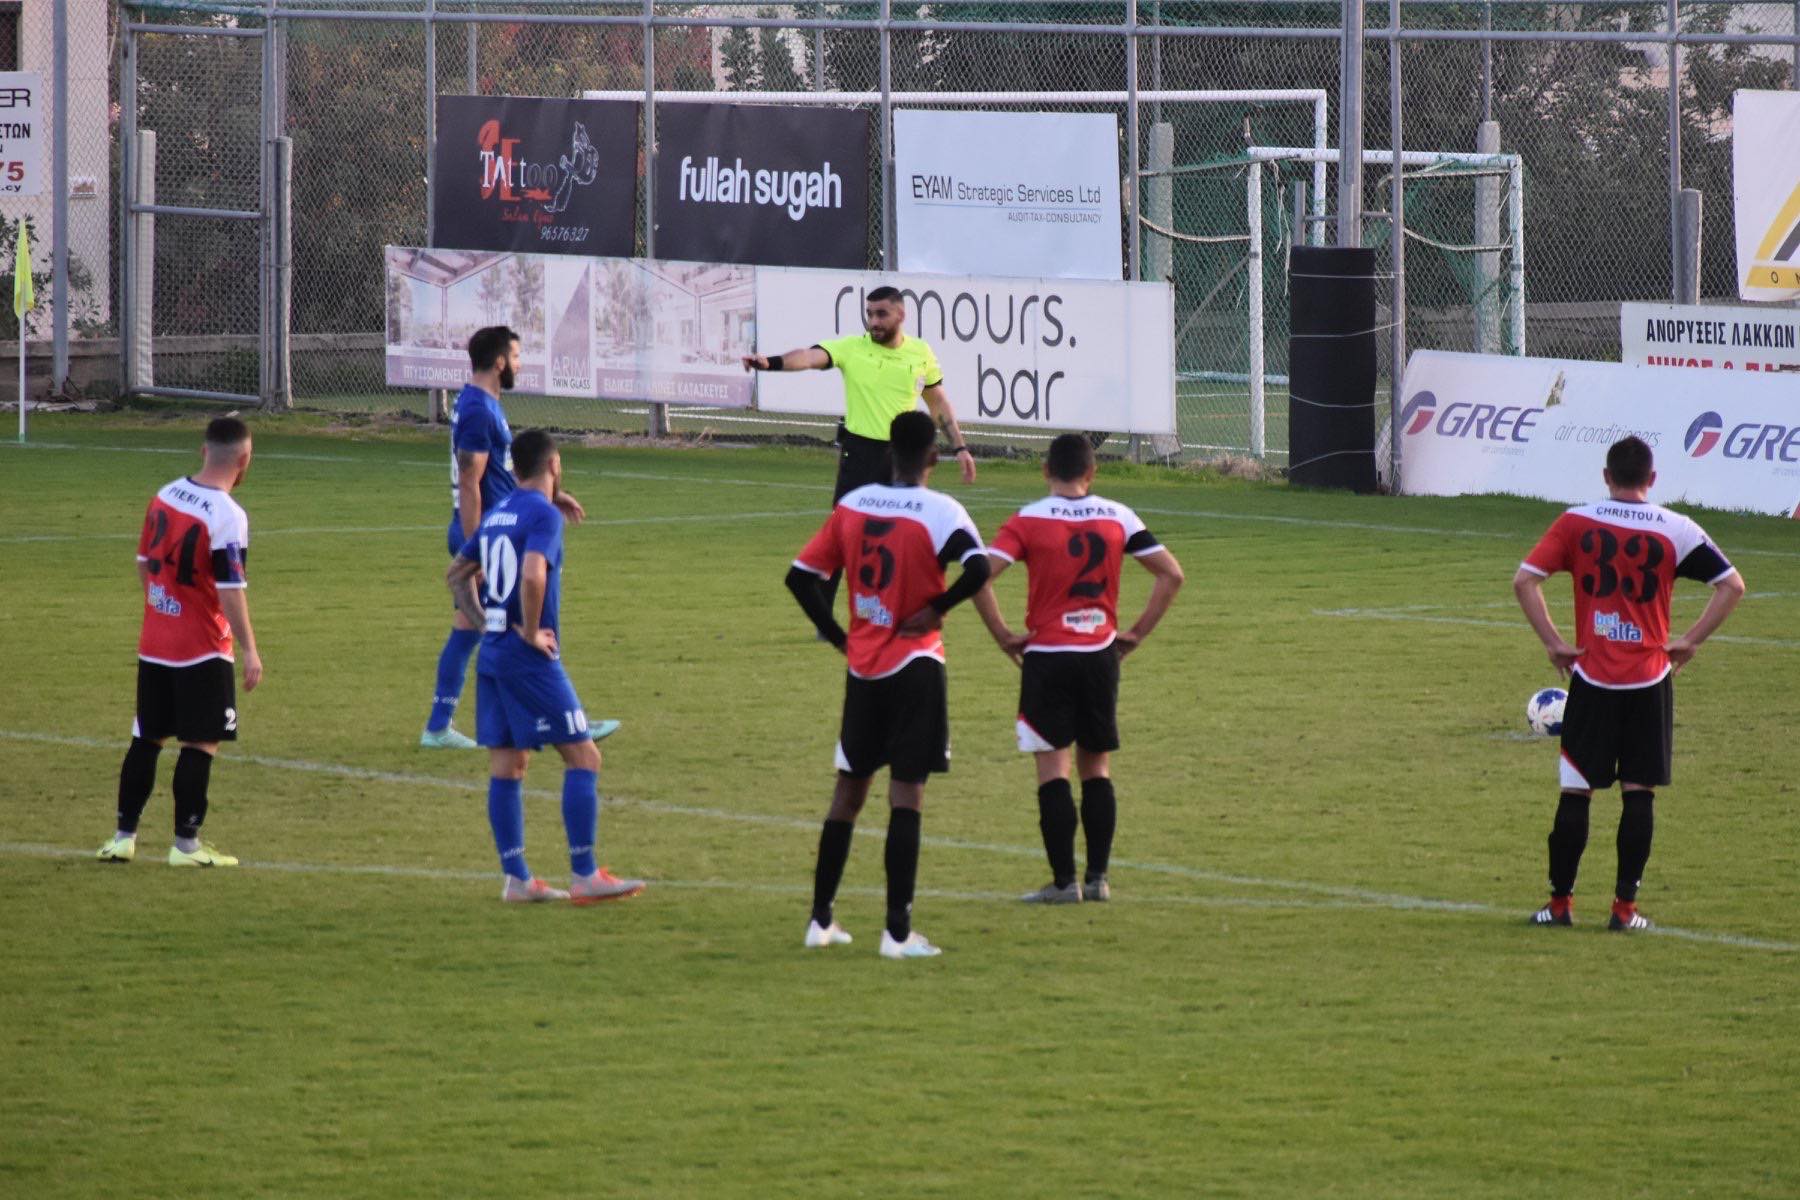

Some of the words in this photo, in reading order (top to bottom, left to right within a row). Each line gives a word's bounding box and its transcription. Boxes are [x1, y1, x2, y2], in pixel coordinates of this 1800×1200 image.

[680, 155, 750, 204] fullah
[754, 161, 842, 222] sugah
[911, 174, 953, 200] EYAM
[958, 182, 1014, 206] Strategic
[1018, 183, 1074, 204] Services
[1080, 184, 1102, 204] Ltd
[540, 226, 590, 242] 96576327
[1647, 318, 1727, 345] ΑΝΟΡΥΞΕΙΣ
[1731, 322, 1795, 348] ΛΑΚΚΩΝ
[977, 353, 1065, 422] bar
[1435, 402, 1544, 443] GREE
[1554, 421, 1575, 441] air
[858, 497, 924, 513] DOUGLAS
[1596, 506, 1652, 521] CHRISTOU
[480, 534, 517, 604] 10
[859, 518, 895, 591] 5
[1068, 530, 1108, 599] 2
[1579, 527, 1665, 604] 33
[1607, 622, 1641, 641] alfa
[565, 710, 588, 735] 10
